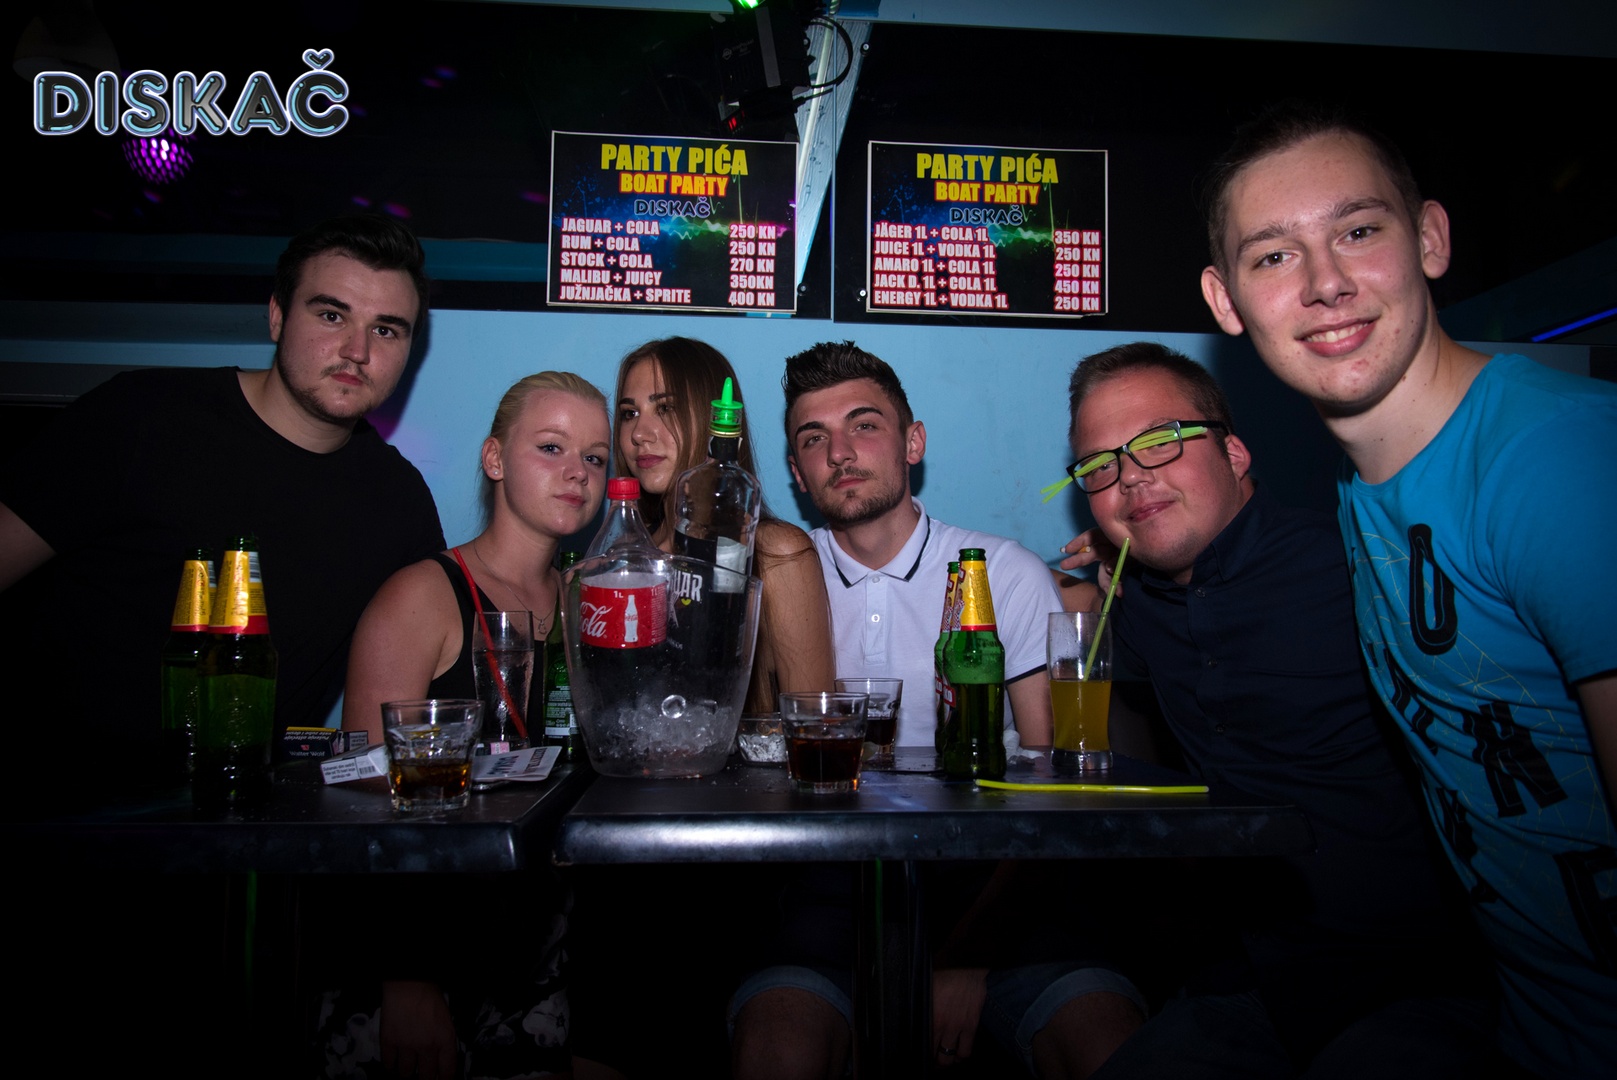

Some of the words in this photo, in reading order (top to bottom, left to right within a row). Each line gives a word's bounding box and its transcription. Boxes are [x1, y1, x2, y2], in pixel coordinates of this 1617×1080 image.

[600, 143, 682, 172] PARTY
[688, 144, 749, 176] PIĆA
[916, 153, 995, 181] PARTY
[1001, 153, 1059, 184] PIĆA
[619, 172, 668, 194] BOAT
[670, 174, 729, 197] PARTY
[935, 180, 982, 202] BOAT
[983, 181, 1040, 205] PARTY
[634, 197, 711, 218] DISKAČ
[949, 204, 1024, 226] DISKAČ
[561, 217, 612, 234] JAGUAR
[614, 222, 624, 231] +
[626, 220, 660, 235] COLA
[729, 223, 756, 239] 250
[758, 225, 776, 240] KN
[874, 221, 913, 240] JÄGER
[914, 225, 928, 240] 1L
[929, 228, 939, 238] +
[941, 226, 974, 242] COLA
[975, 227, 989, 242] 1L
[561, 235, 592, 250] RUM
[594, 239, 604, 248] +
[606, 236, 640, 251] COLA
[1054, 230, 1080, 246] 350
[1082, 231, 1100, 246] KN
[729, 241, 756, 256] 250
[757, 241, 776, 257] KN
[874, 240, 910, 256] JUICE
[911, 241, 925, 256] 1L
[926, 244, 936, 254] +
[937, 243, 980, 258] VODKA
[982, 244, 996, 259] 1L
[1054, 247, 1080, 262] 250
[1082, 248, 1100, 262] KN
[561, 251, 605, 268] STOCK
[607, 256, 617, 265] +
[618, 253, 653, 269] COLA
[729, 257, 755, 273] 270
[757, 258, 775, 273] KN
[874, 257, 919, 272] AMARO
[921, 258, 934, 273] 1L
[936, 261, 946, 271] +
[948, 259, 980, 274] COLA
[982, 260, 996, 275] 1L
[560, 269, 611, 284] MALIBU
[613, 273, 623, 283] +
[624, 270, 663, 287] JUICY
[1054, 263, 1080, 278] 250
[1082, 264, 1100, 279] KN
[729, 274, 775, 290] 350KN
[874, 273, 905, 289] JACK
[907, 274, 921, 290] D.
[922, 275, 936, 290] 1L
[938, 278, 947, 288] +
[949, 276, 982, 291] COLA
[983, 277, 997, 292] 1L
[1054, 280, 1080, 295] 450
[1082, 280, 1100, 295] KN
[559, 284, 632, 302] JUŽNJAČKA
[633, 290, 643, 300] +
[645, 288, 692, 304] SPRITE
[728, 290, 755, 306] 400
[757, 291, 776, 307] KN
[874, 290, 922, 306] ENERGY
[923, 292, 937, 307] 1L
[939, 295, 948, 304] +
[949, 292, 993, 308] VODKA
[995, 294, 1008, 309] 1L
[1054, 296, 1080, 311] 250
[1082, 297, 1100, 311] KN
